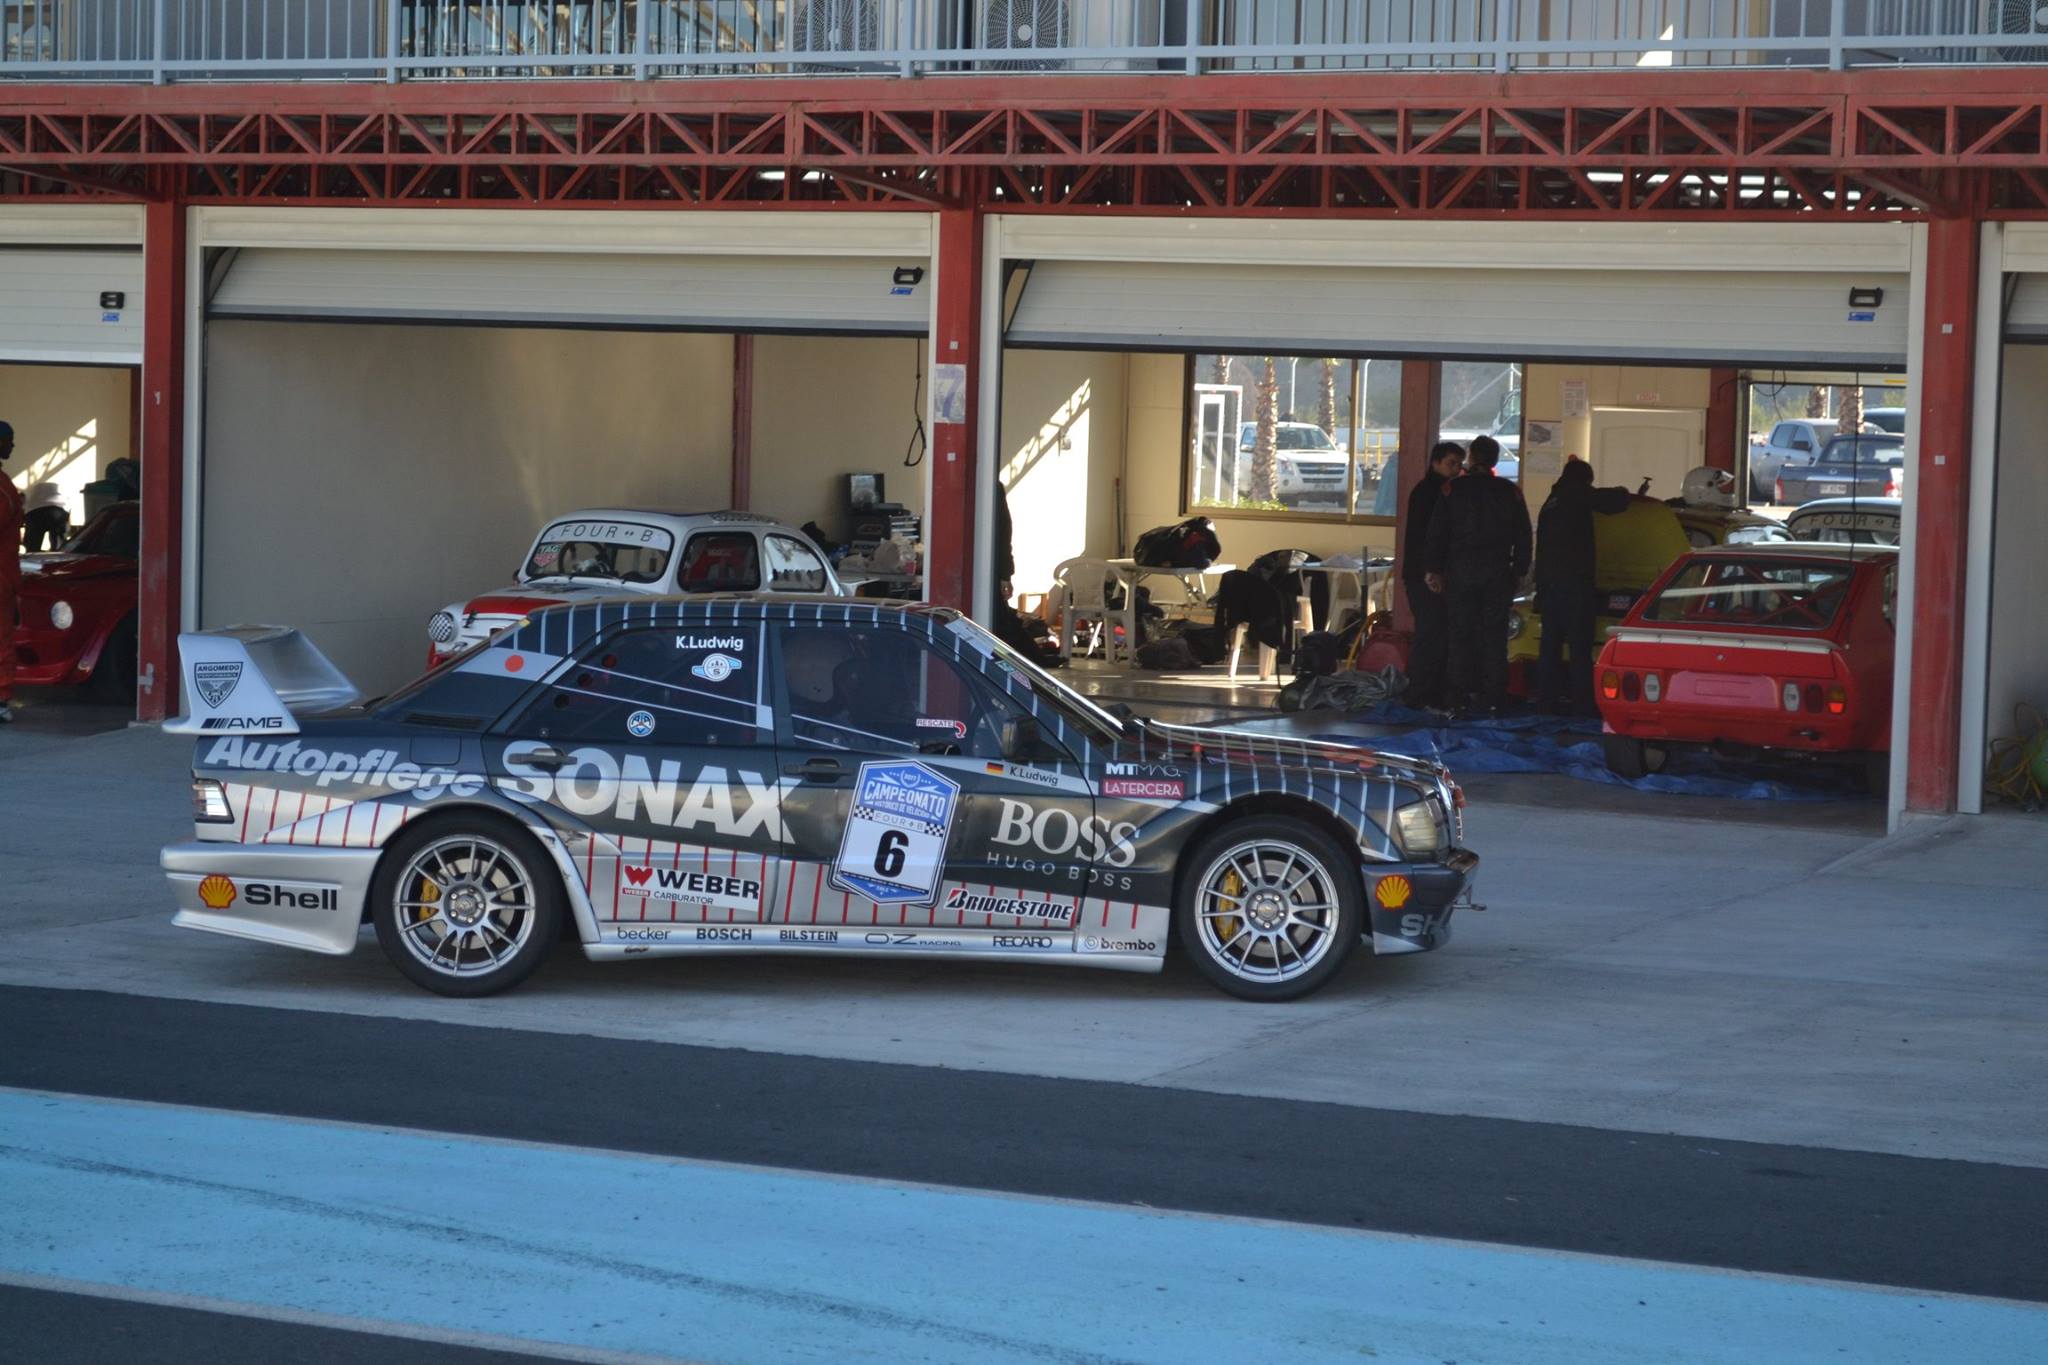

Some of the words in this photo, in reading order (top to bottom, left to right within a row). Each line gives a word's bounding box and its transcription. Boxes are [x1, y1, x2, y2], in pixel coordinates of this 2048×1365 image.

[935, 368, 965, 418] 7
[1809, 514, 1869, 527] FOUR
[560, 524, 619, 540] FOUR
[640, 529, 654, 543] B
[675, 635, 744, 652] K.Ludwig
[198, 664, 240, 672] ARGOMEDO
[227, 717, 283, 729] AMG
[917, 719, 953, 727] RESCATE
[203, 735, 485, 801] Autopflege
[1009, 766, 1059, 786] K.Ludwig
[497, 740, 802, 845] SONAX
[864, 780, 946, 818] CAMPEONATO
[874, 811, 906, 825] FOUR
[991, 797, 1141, 868] BOSS
[874, 829, 909, 878] 6
[987, 851, 1055, 876] HUGO
[1068, 866, 1132, 890] BOSS
[657, 868, 760, 900] WEBER
[244, 883, 338, 911] Shell
[653, 890, 713, 905] CARBURATOR
[947, 888, 1075, 920] BRIDGESTONE
[617, 926, 671, 940] becker
[696, 928, 752, 941] BOSCH
[779, 929, 838, 942] BILSTEIN
[992, 935, 1053, 949] RECARO
[1101, 937, 1156, 951] brembo
